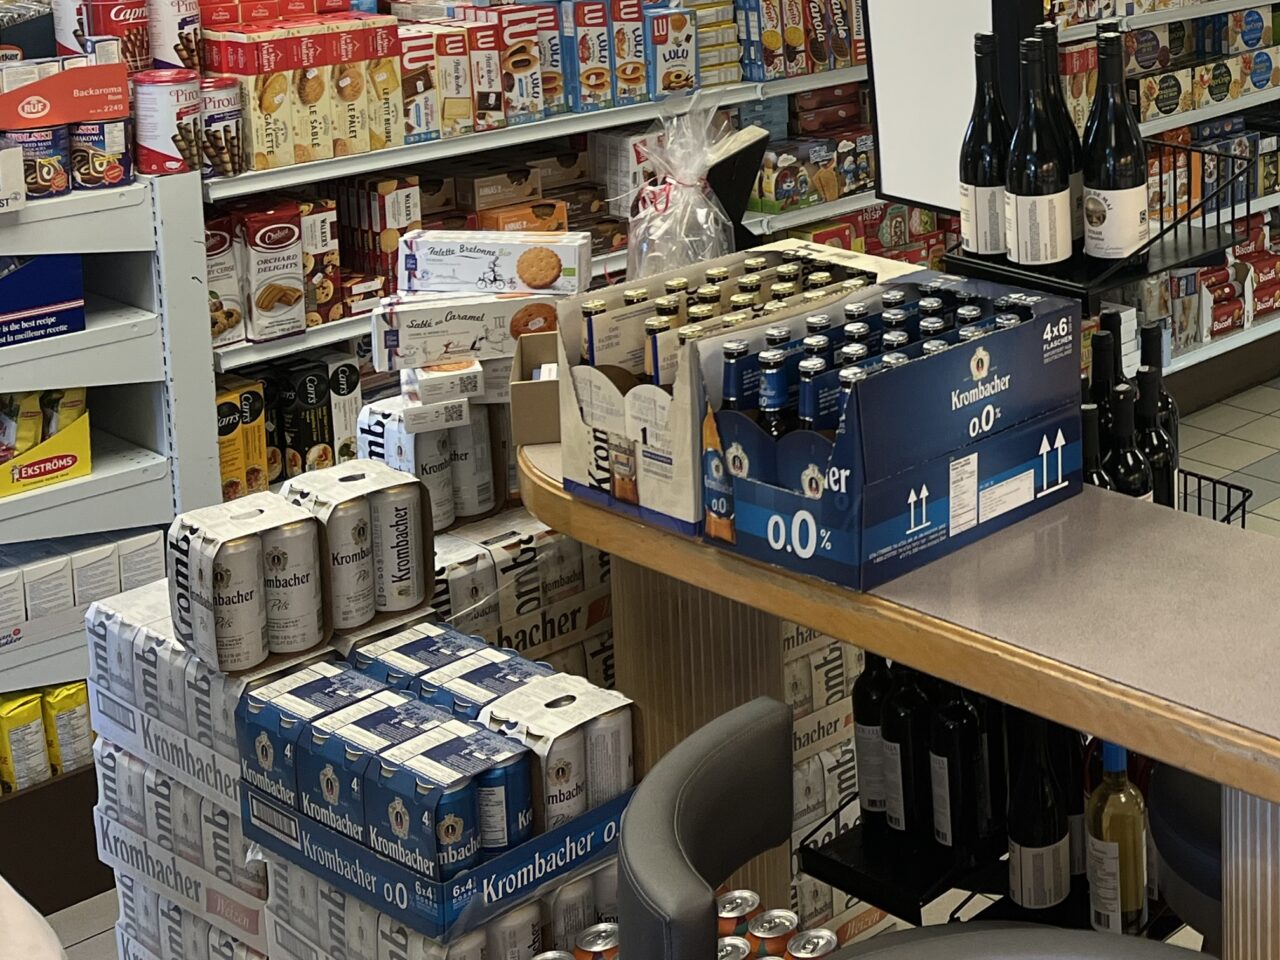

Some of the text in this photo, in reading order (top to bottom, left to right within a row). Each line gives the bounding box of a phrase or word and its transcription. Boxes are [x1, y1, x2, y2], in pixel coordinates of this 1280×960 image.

[583, 4, 603, 24] LU
[620, 0, 638, 19] LU
[502, 8, 538, 46] LU
[653, 18, 667, 36] LU
[445, 36, 464, 53] LU
[477, 30, 495, 48] LU
[596, 32, 608, 64] LULU
[632, 27, 643, 59] LULU
[402, 39, 434, 69] LU
[548, 36, 561, 68] LULU
[662, 49, 689, 63] LULU
[73, 86, 122, 97] Backaroma
[382, 88, 389, 97] LE
[529, 71, 541, 99] LULU
[104, 104, 123, 112] 2249
[309, 105, 320, 148] LE SABLÉ
[347, 103, 357, 139] LE PALET
[264, 113, 274, 156] GALETTE
[257, 254, 298, 266] ORCHARD
[459, 244, 496, 257] Bretonne
[1235, 243, 1256, 256] Biscoff
[257, 262, 298, 274] DELIGHTS
[1259, 269, 1275, 282] Biscoff
[1256, 298, 1273, 311] Biscoff
[9, 322, 20, 331] the
[21, 320, 36, 329] best
[36, 316, 57, 326] recipe
[406, 319, 433, 329] Sablé
[444, 311, 485, 323] Caramel
[1043, 317, 1068, 341] 4x6
[1213, 317, 1232, 331] Biscoff
[7, 334, 14, 342] la
[14, 329, 46, 340] meilleure
[46, 324, 68, 334] recette
[1043, 335, 1073, 351] FLASCHEN
[306, 376, 318, 404] Carr's
[338, 367, 350, 394] Carr's
[951, 374, 1011, 410] Krombacher
[241, 393, 253, 423] Carr's
[21, 457, 73, 478] EKSTRÖMS
[390, 506, 408, 584] Krombacher
[269, 598, 290, 611] Pils
[241, 758, 295, 805] Krombacher
[302, 792, 363, 841] Krombacher
[99, 815, 201, 902] Krombacher
[369, 825, 434, 877] Krombacher
[302, 831, 408, 910] Krombacher 0.0
[482, 830, 595, 906] Krombacher
[415, 882, 433, 899] 6x4
[453, 878, 473, 896] 6x4
[214, 895, 250, 926] Weizen
[844, 909, 885, 936] Weizen
